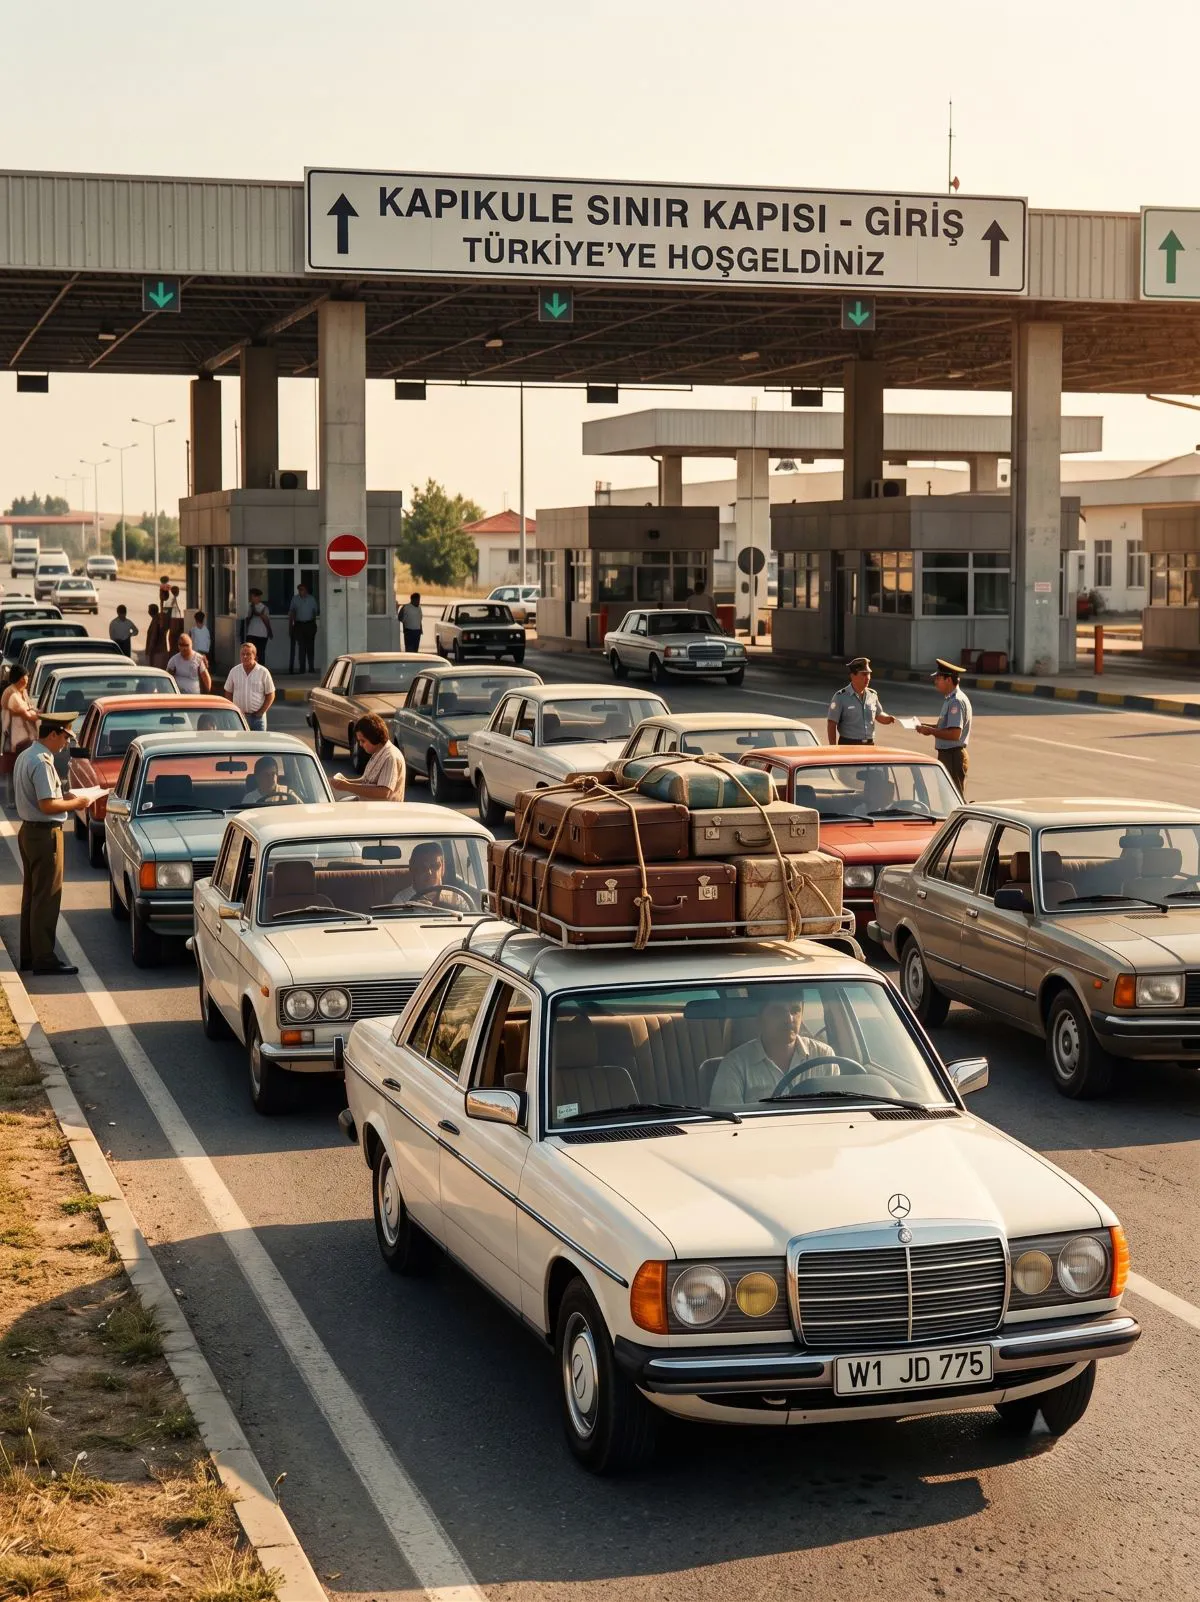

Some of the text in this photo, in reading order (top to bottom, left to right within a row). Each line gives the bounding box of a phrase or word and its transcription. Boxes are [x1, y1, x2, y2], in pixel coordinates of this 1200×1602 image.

[379, 186, 964, 247] KAPIKULE SINIR KAPISI - GİRİŞ
[462, 230, 885, 277] TÜRKİYE'YE HOŞGELDİNİZ
[847, 1350, 984, 1388] W1 JD 775
